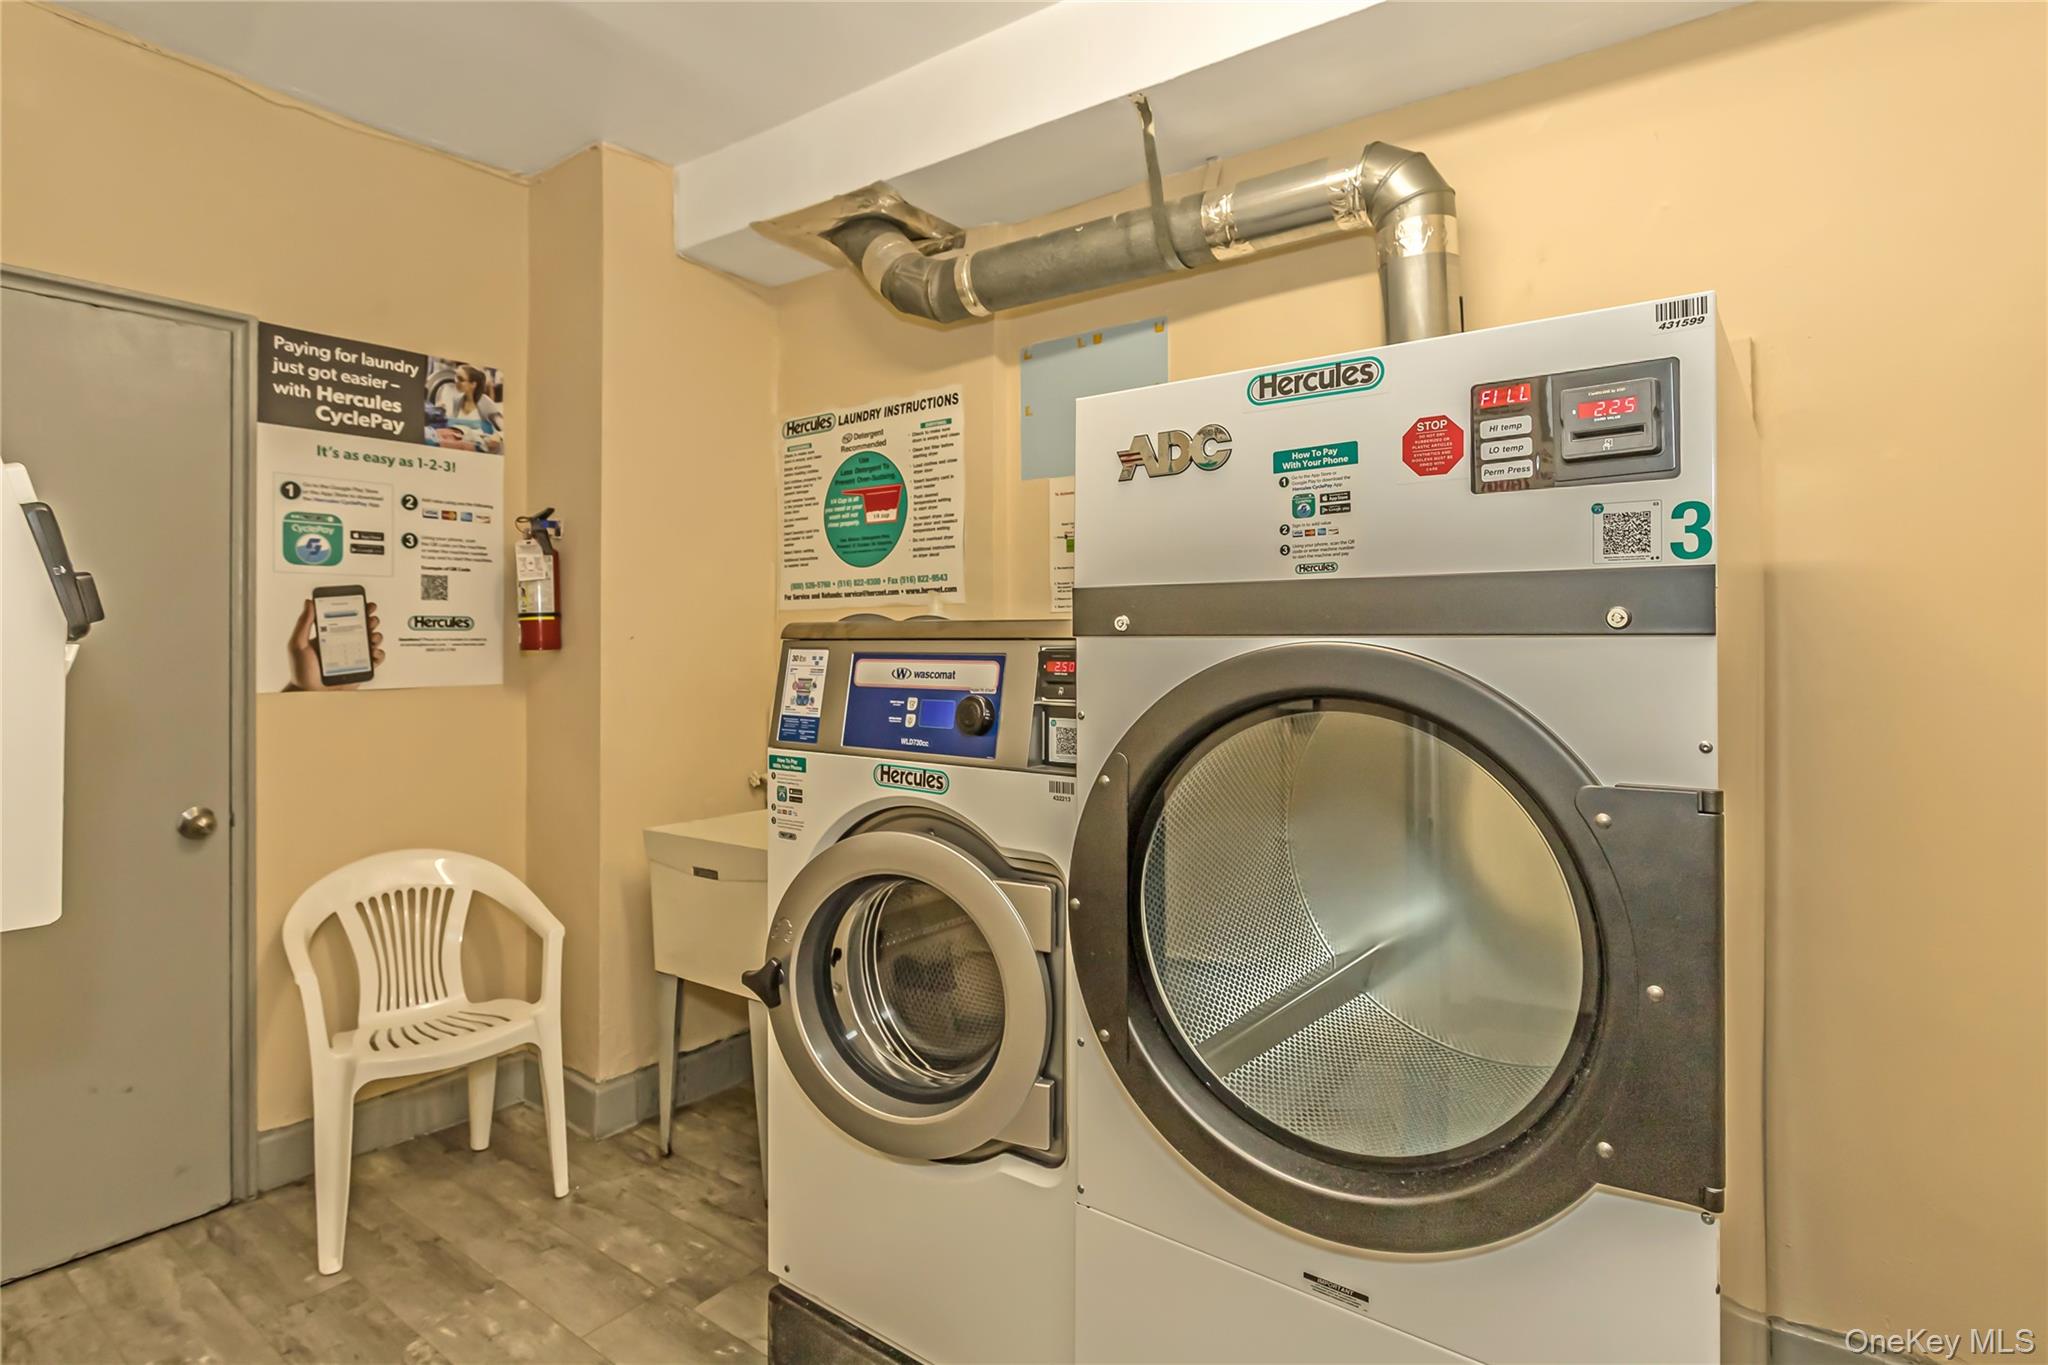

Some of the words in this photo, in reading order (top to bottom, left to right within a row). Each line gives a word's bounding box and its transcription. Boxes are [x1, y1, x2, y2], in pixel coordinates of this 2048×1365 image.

[1658, 316, 1705, 331] 431599
[273, 335, 331, 362] Paying
[334, 347, 356, 364] for
[361, 351, 419, 378] laundry
[272, 358, 304, 375] just
[308, 365, 337, 382] got
[340, 371, 388, 390] easier
[1259, 361, 1374, 399] Hercules
[272, 382, 311, 399] with
[316, 385, 402, 413] Hercules
[1481, 386, 1528, 407] FILL
[786, 415, 833, 436] Hercules
[838, 407, 882, 426] LAUNDRY
[884, 392, 960, 418] INSTRUCTIONS
[1594, 397, 1635, 417] 2.25
[315, 405, 405, 435] CyclePay
[1416, 420, 1448, 431] STOP
[1501, 422, 1523, 431] temp
[854, 428, 884, 440] Detergent
[841, 439, 887, 453] Recommended
[1116, 423, 1232, 482] ADC
[1291, 451, 1310, 460] How
[1312, 449, 1321, 457] To
[1323, 448, 1338, 456] Pay
[1502, 444, 1524, 453] temp
[317, 445, 339, 459] It's
[343, 450, 360, 461] as
[363, 453, 396, 467] easy
[398, 457, 414, 469] as
[418, 458, 456, 473] 1-2-3!
[1282, 460, 1301, 470] With
[1302, 458, 1322, 468] Your
[1322, 455, 1349, 465] Phone
[1483, 468, 1505, 477] Perm
[1507, 466, 1531, 474] Press
[1670, 500, 1713, 560] 3
[1299, 563, 1335, 573] Hercules
[900, 575, 916, 585] (516)
[414, 616, 470, 629] Hercules
[914, 669, 956, 681] wascomat
[880, 766, 944, 790] Hercules
[1317, 1278, 1354, 1296] IMPORTANT
